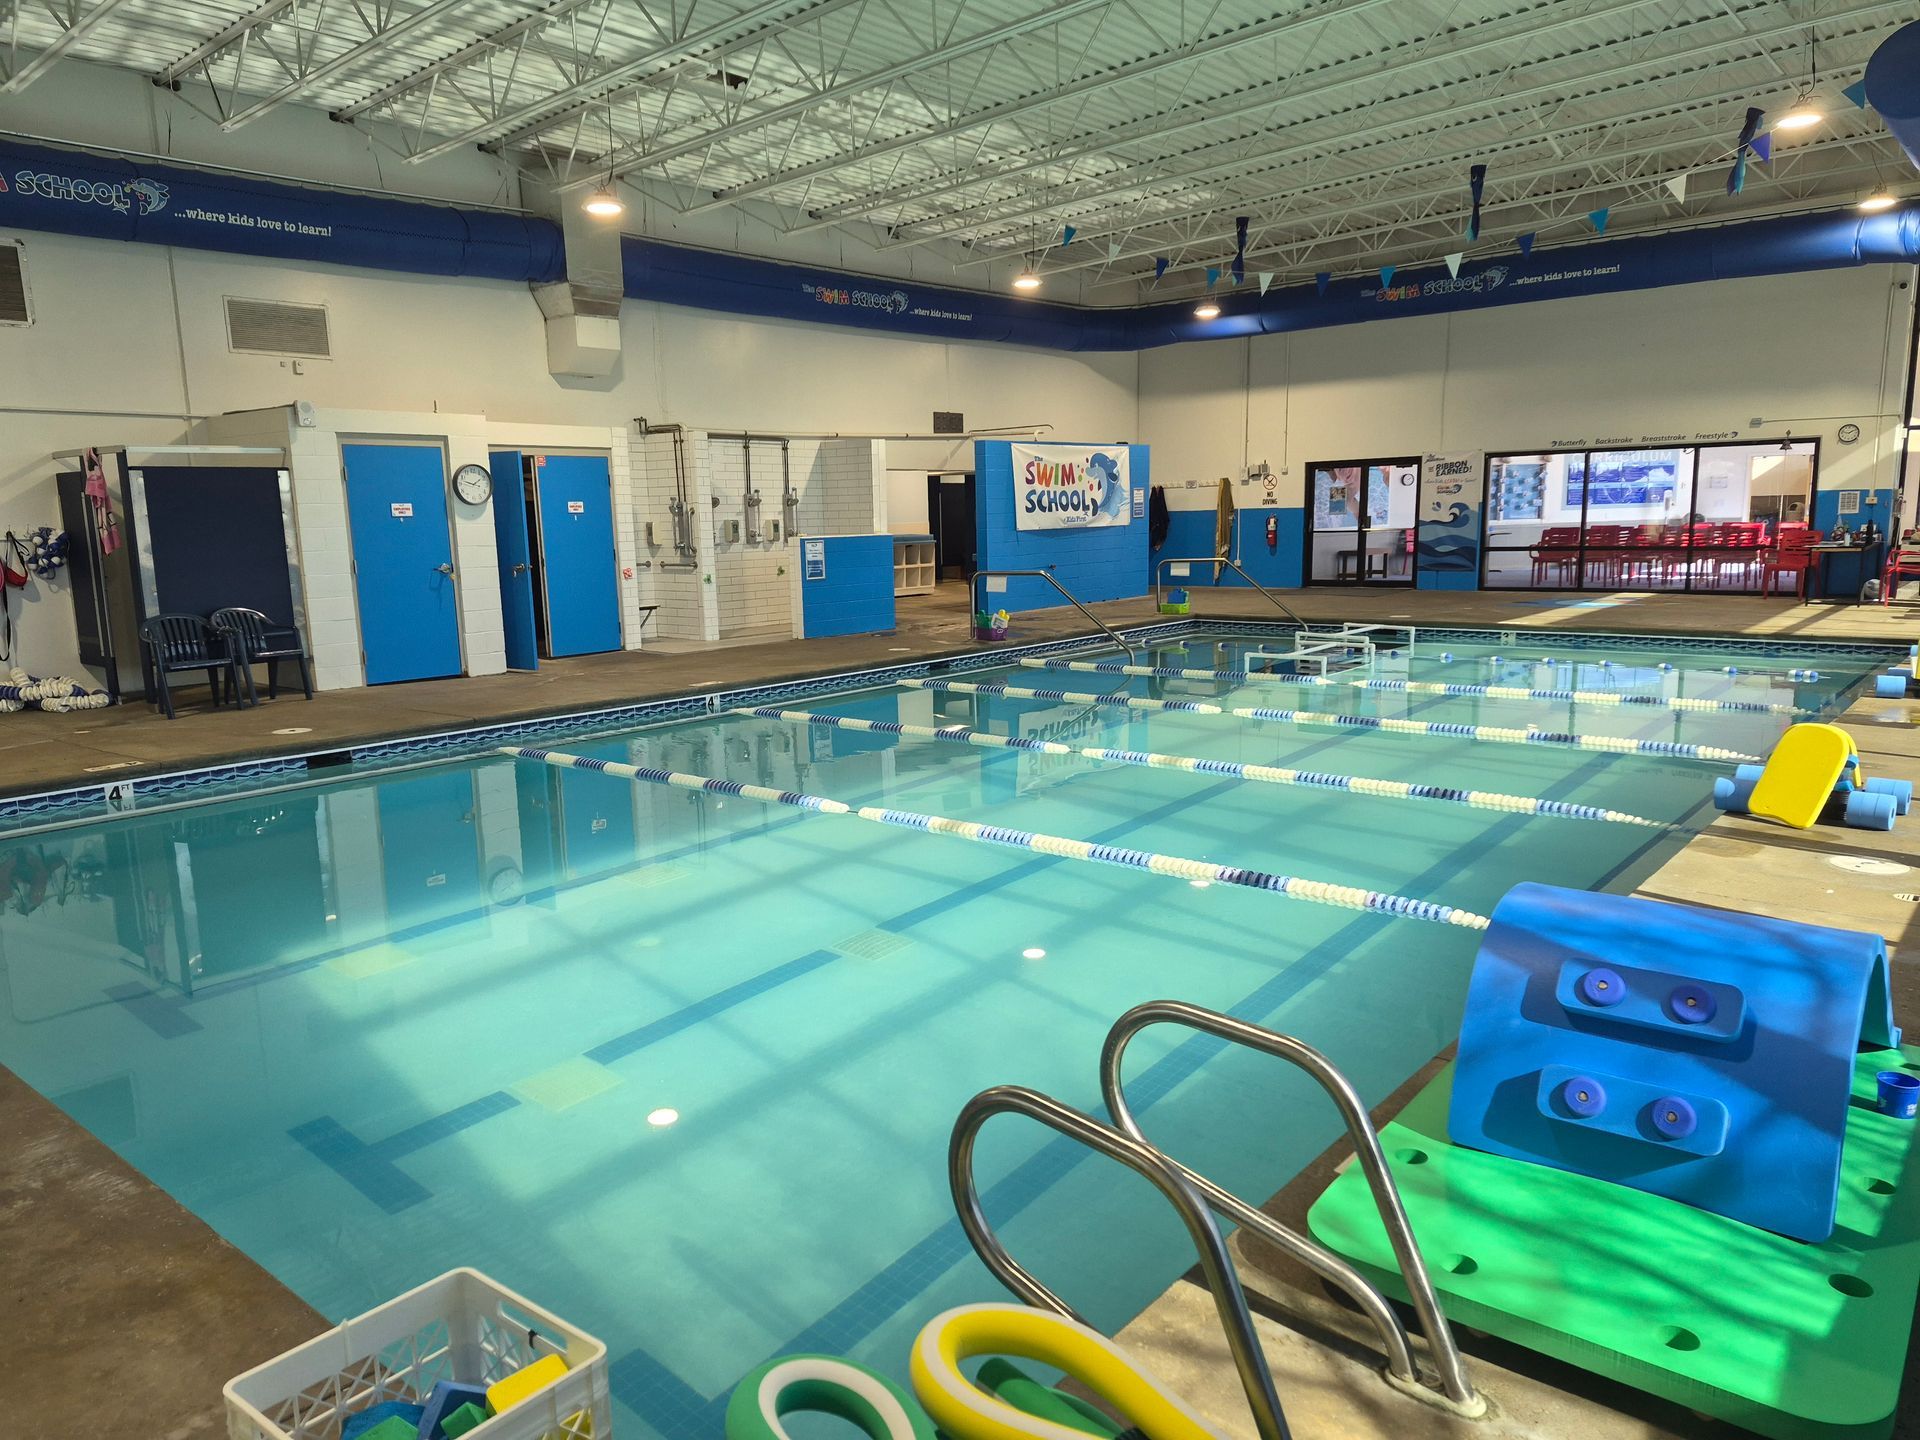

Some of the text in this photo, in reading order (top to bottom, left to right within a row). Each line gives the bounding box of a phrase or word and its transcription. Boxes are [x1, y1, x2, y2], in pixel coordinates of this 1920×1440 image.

[15, 171, 130, 208] SCHOOL
[174, 208, 332, 237] ...where kids love to learn!
[1544, 272, 1563, 282] kids
[1564, 270, 1582, 279] love
[1583, 268, 1592, 276] to
[1593, 264, 1620, 275] learn!
[1376, 275, 1483, 302] SWIM SCHOOL
[816, 286, 894, 311] SWIM SCHOOL
[930, 308, 941, 318] kids
[942, 310, 952, 319] love
[1557, 431, 1728, 447] Butterfly Backstroke Breaststroke Freestyle
[1025, 460, 1076, 488] SWIM
[1435, 459, 1468, 472] RIBBON
[1435, 465, 1473, 477] EARNED!
[1025, 489, 1090, 513] SCHOOL
[707, 696, 715, 706] 4
[108, 783, 130, 800] 4 FT
